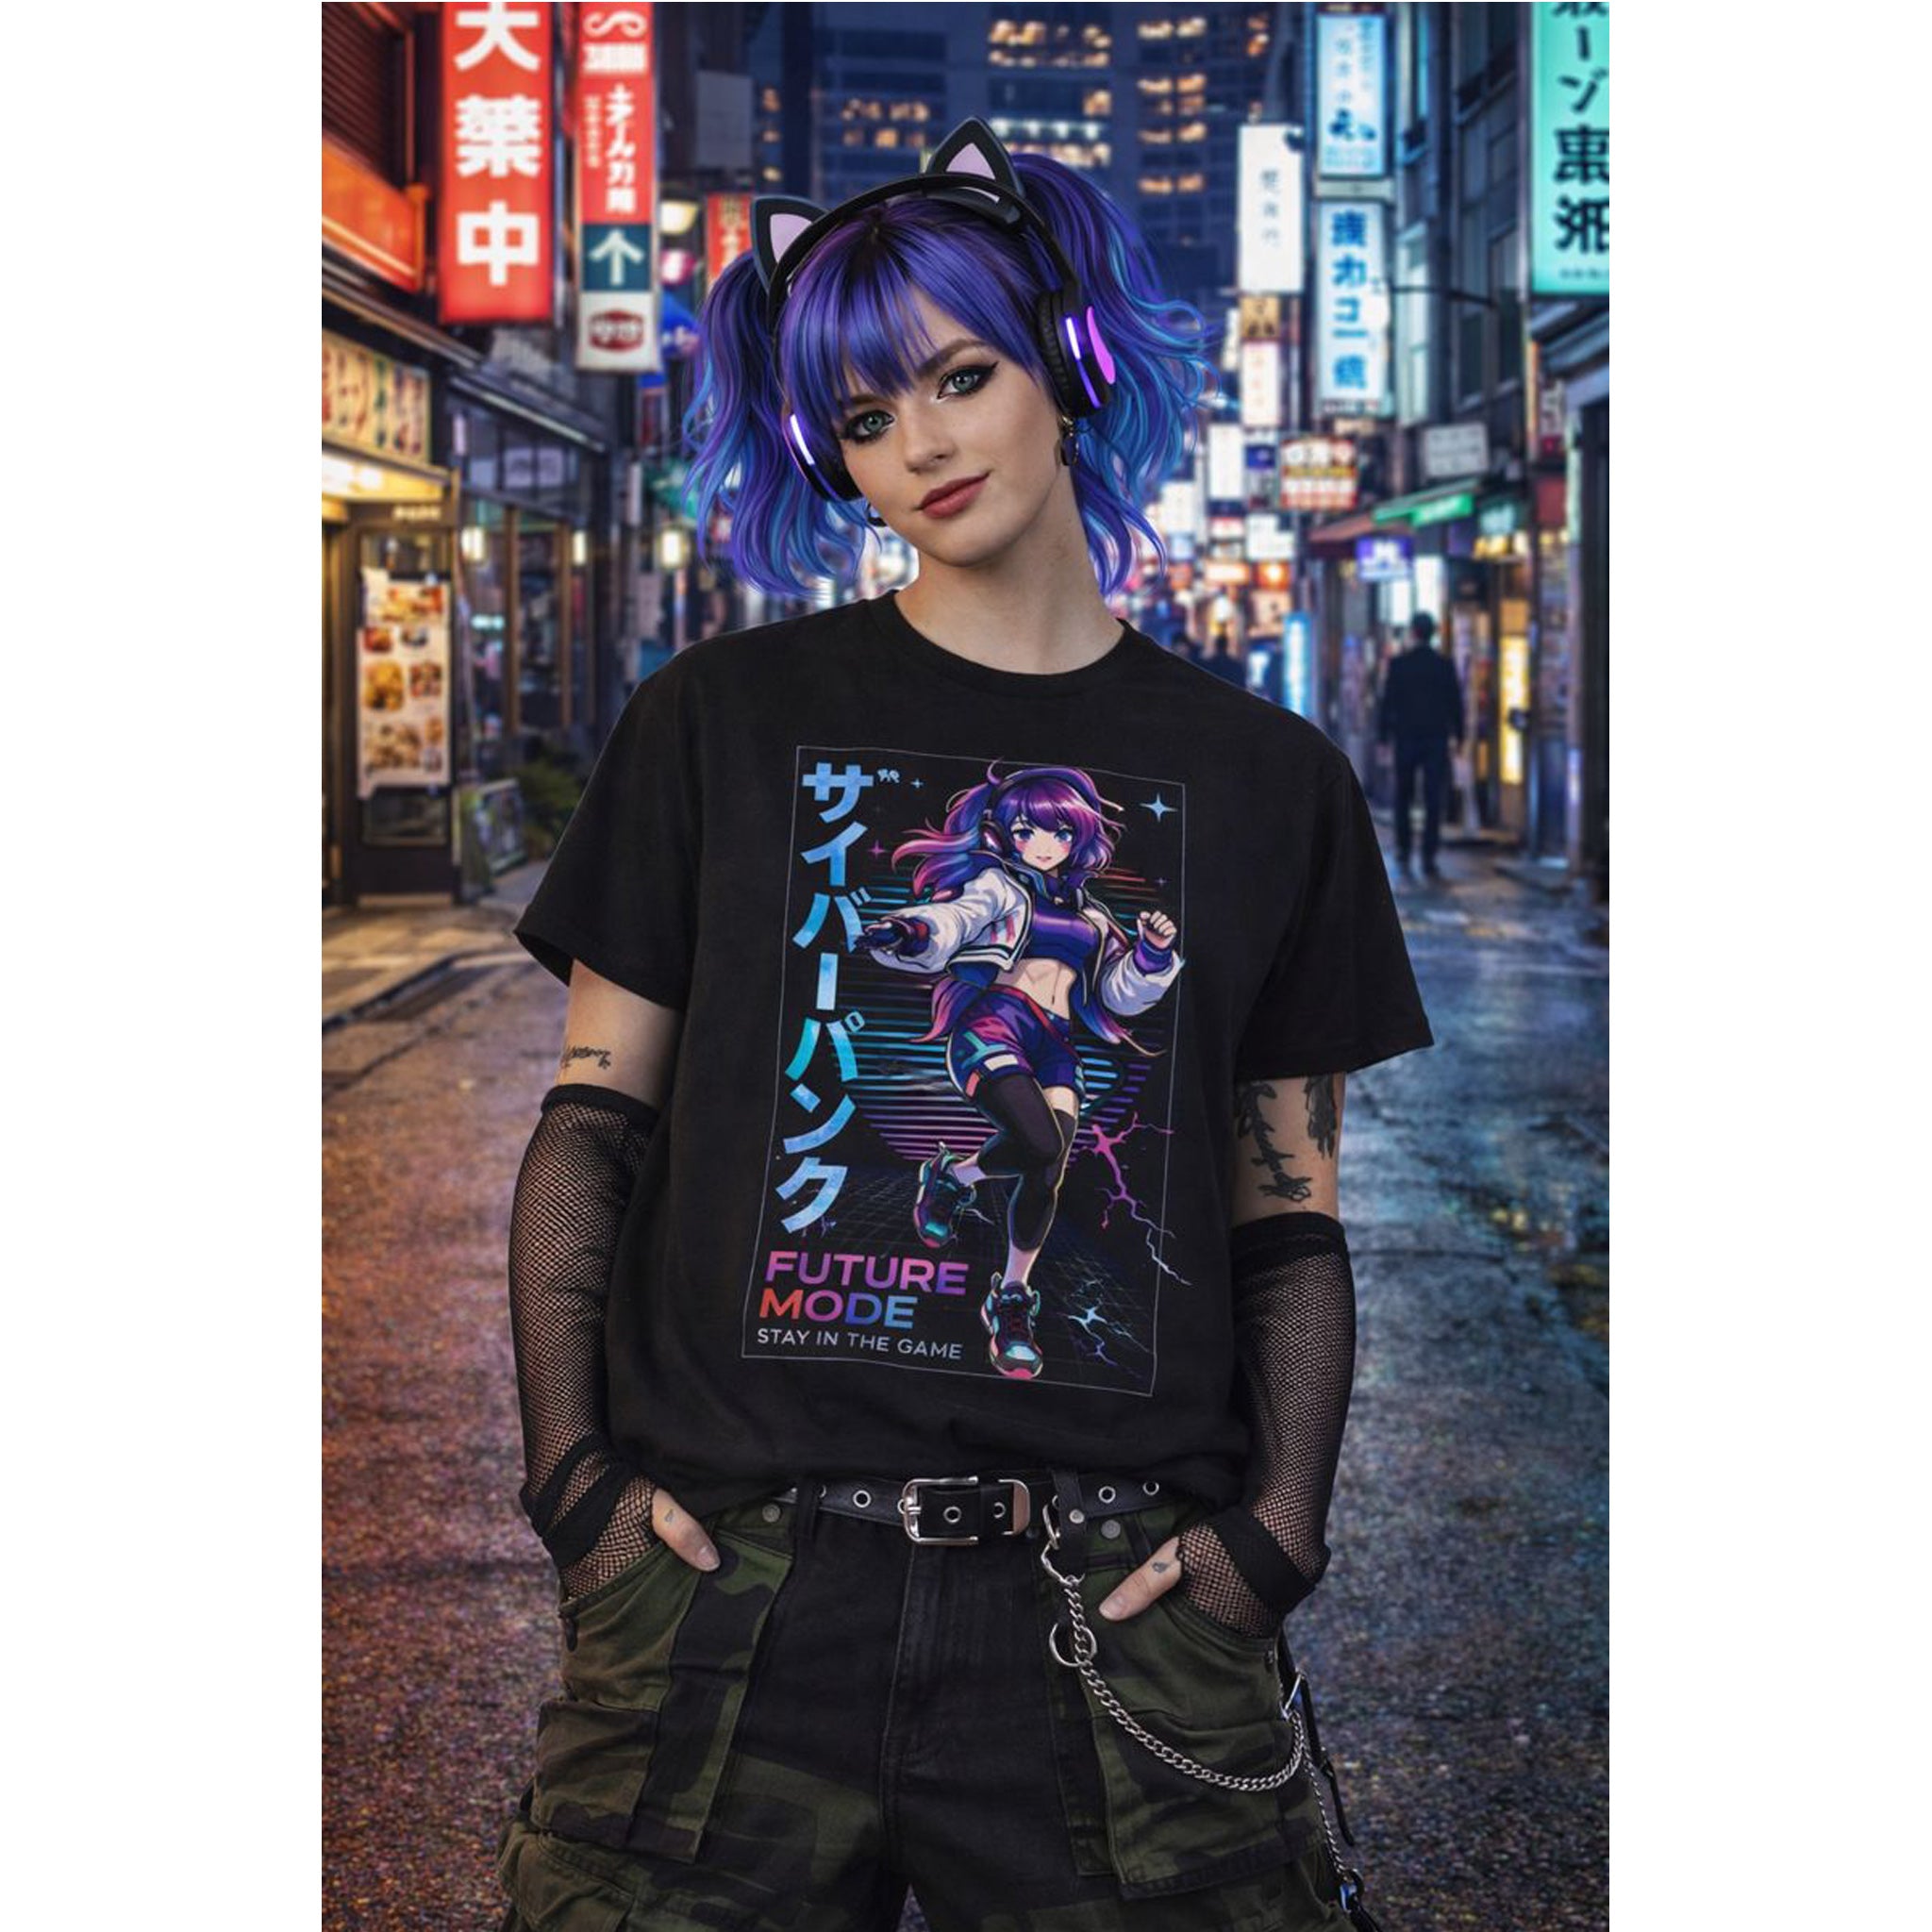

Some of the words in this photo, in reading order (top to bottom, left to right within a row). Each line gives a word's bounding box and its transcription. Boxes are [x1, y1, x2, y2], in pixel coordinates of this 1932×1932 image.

[765, 1251, 969, 1295] FUTURE
[758, 1288, 918, 1329] MODE
[757, 1327, 810, 1345] STAY
[816, 1331, 839, 1346] IN
[847, 1332, 890, 1352] THE
[897, 1338, 963, 1359] GAME
